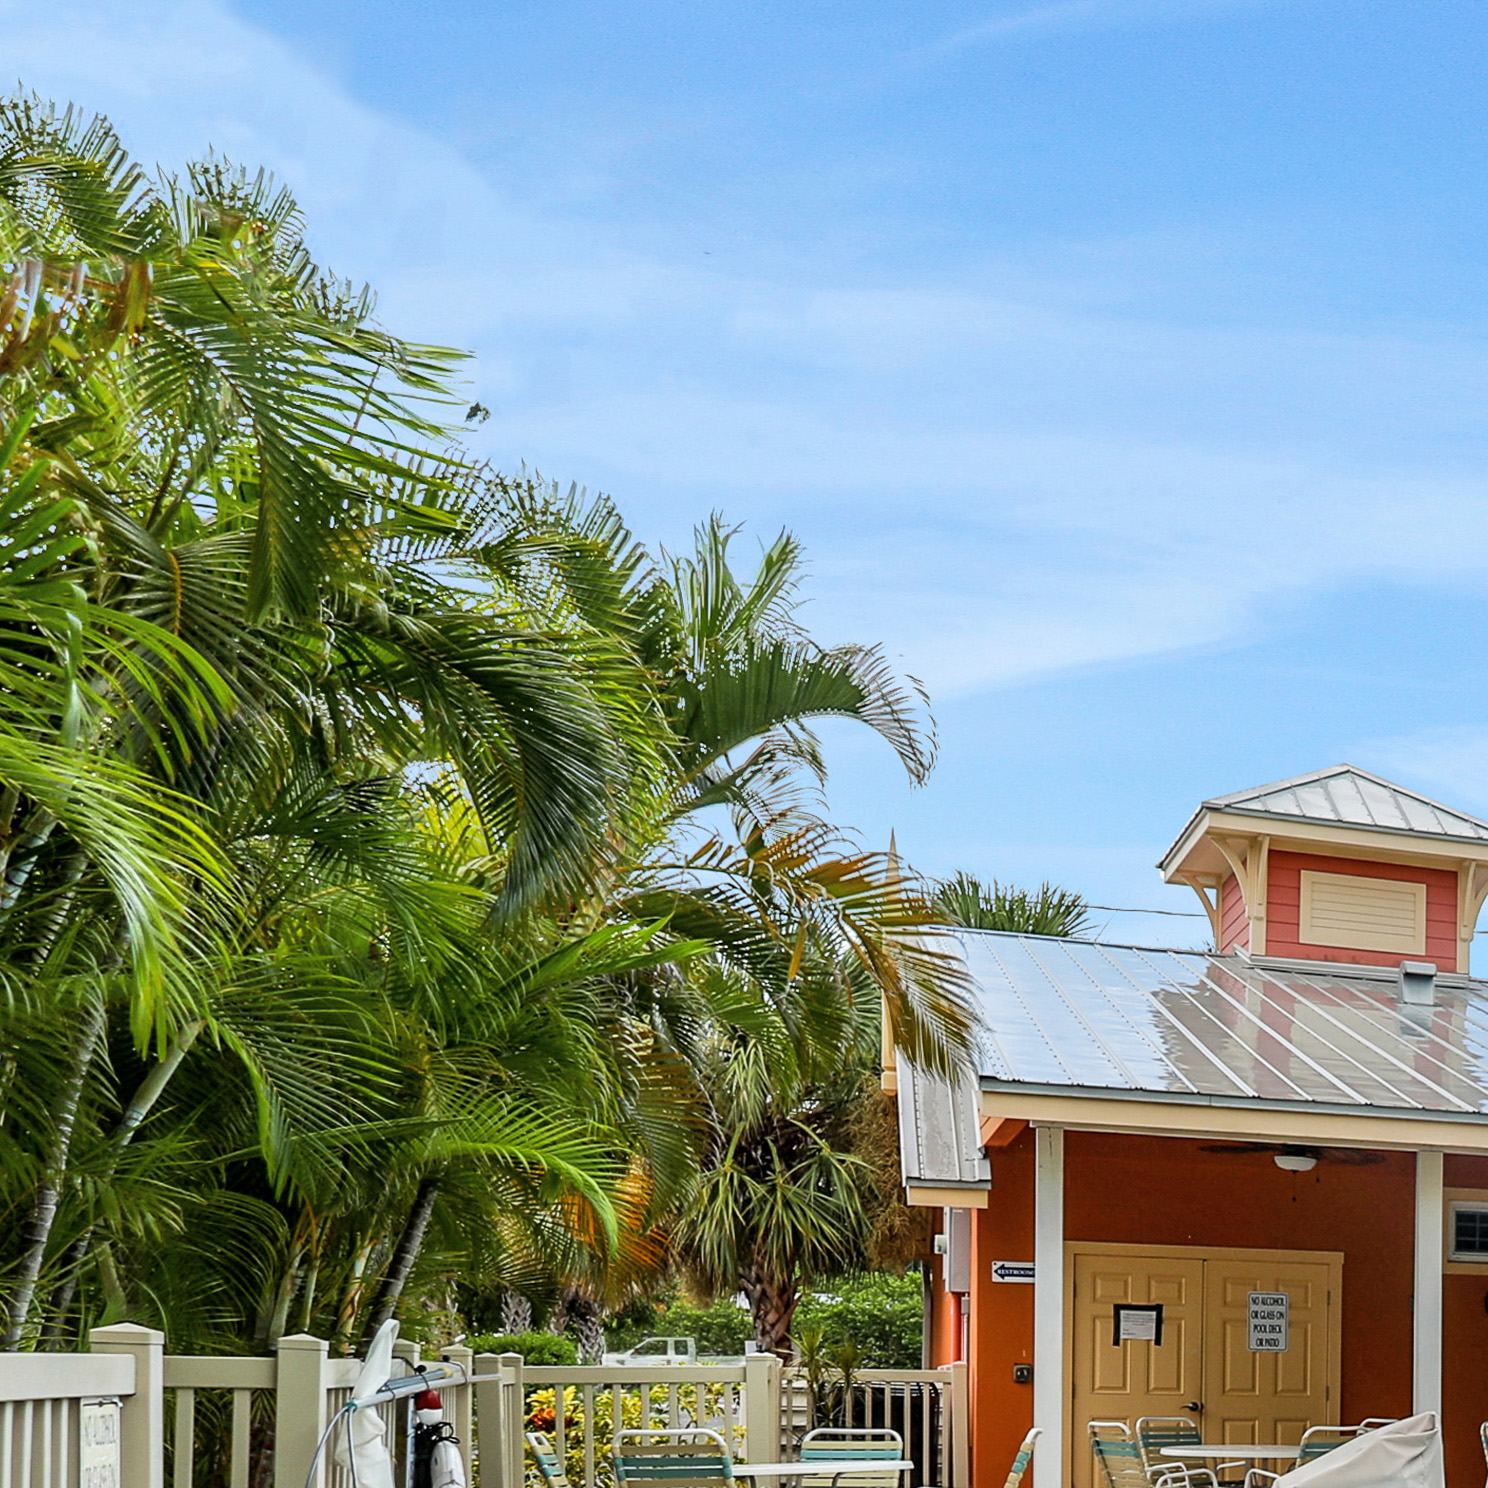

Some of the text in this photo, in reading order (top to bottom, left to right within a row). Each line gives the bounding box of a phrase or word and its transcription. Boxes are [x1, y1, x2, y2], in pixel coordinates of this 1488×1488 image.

[1251, 1297, 1284, 1306] NO ALCOHOL
[1251, 1310, 1284, 1320] OR GLASS ON
[1253, 1324, 1282, 1334] POOL DECK
[1256, 1338, 1279, 1347] OR PATIO
